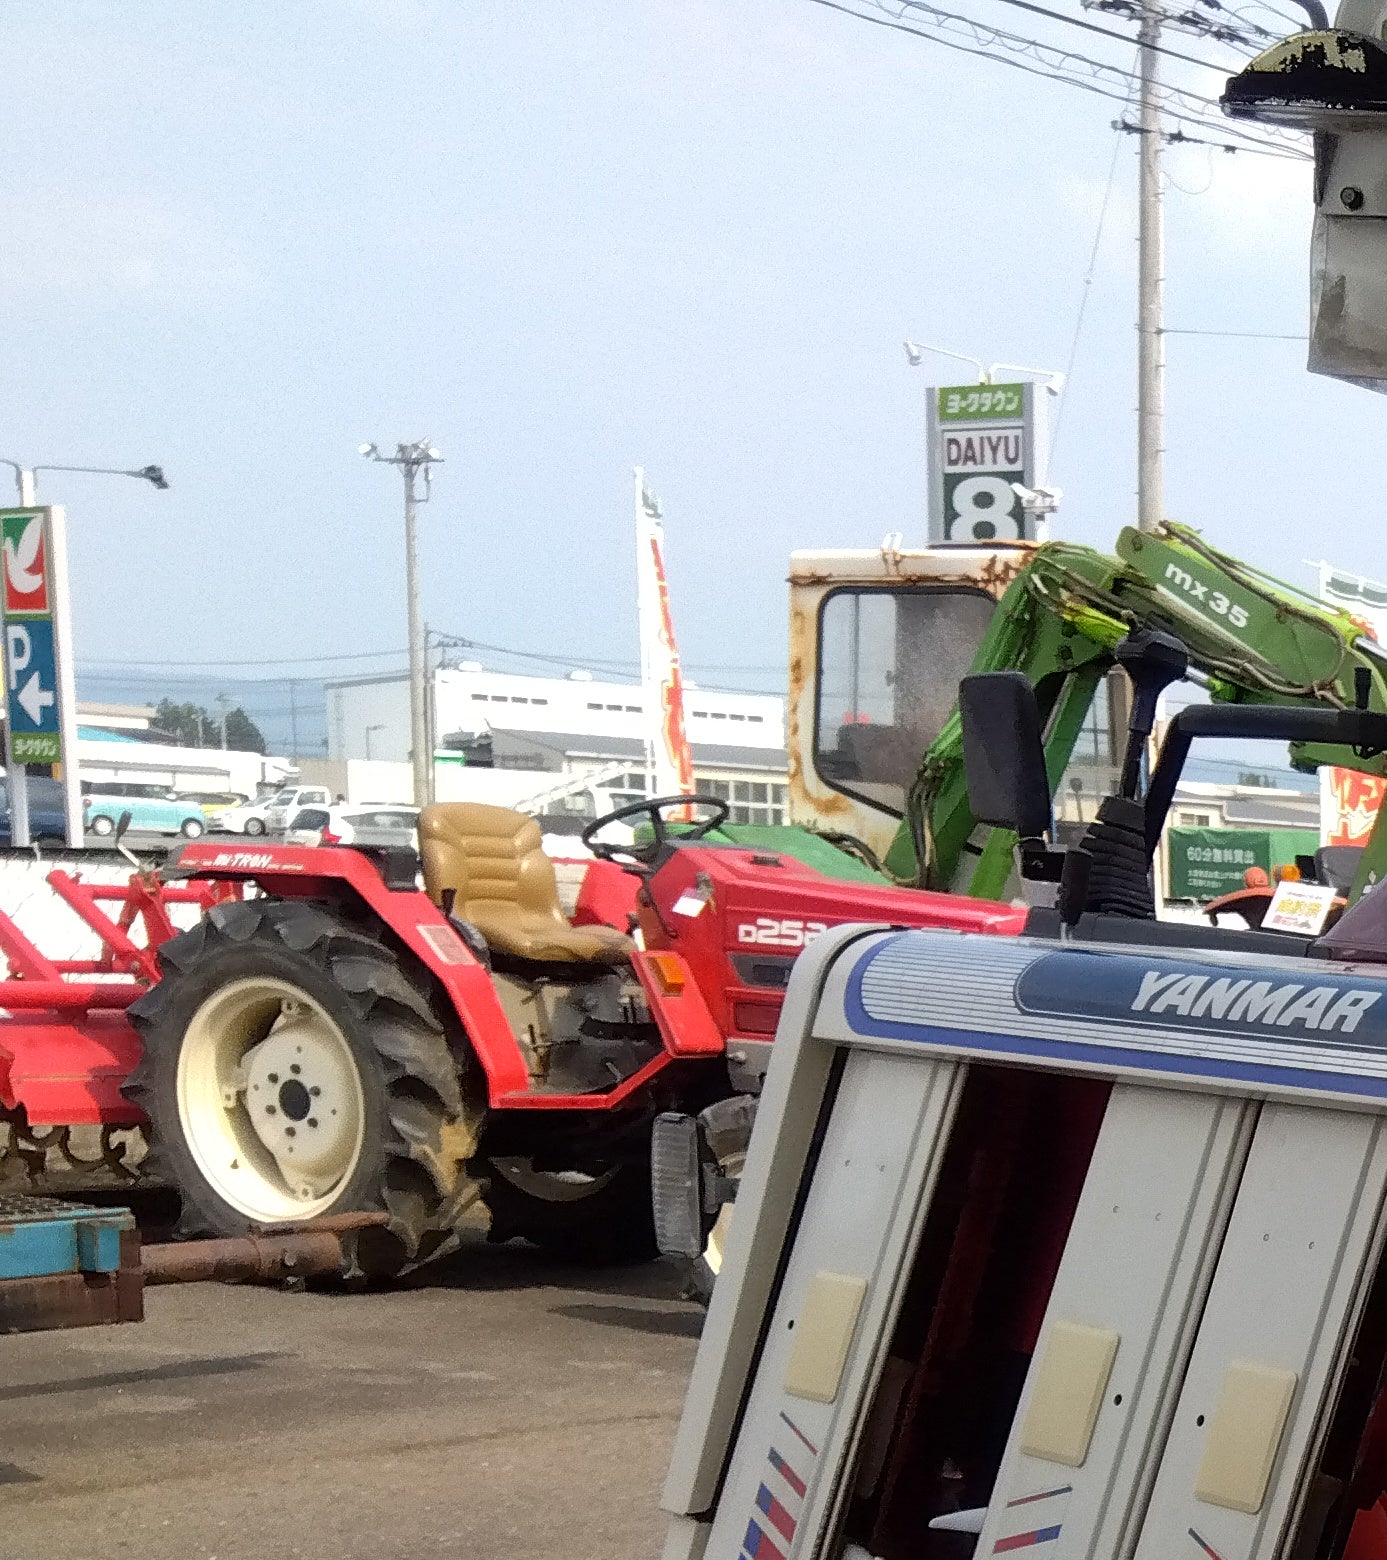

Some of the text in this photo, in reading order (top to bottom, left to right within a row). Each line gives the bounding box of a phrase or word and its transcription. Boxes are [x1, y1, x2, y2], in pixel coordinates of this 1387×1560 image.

[946, 391, 1020, 413] ヨークタウン
[946, 435, 1020, 467] DAIYU
[951, 476, 1019, 541] 8
[6, 624, 31, 690] P
[1131, 971, 1382, 1033] YANMAR
